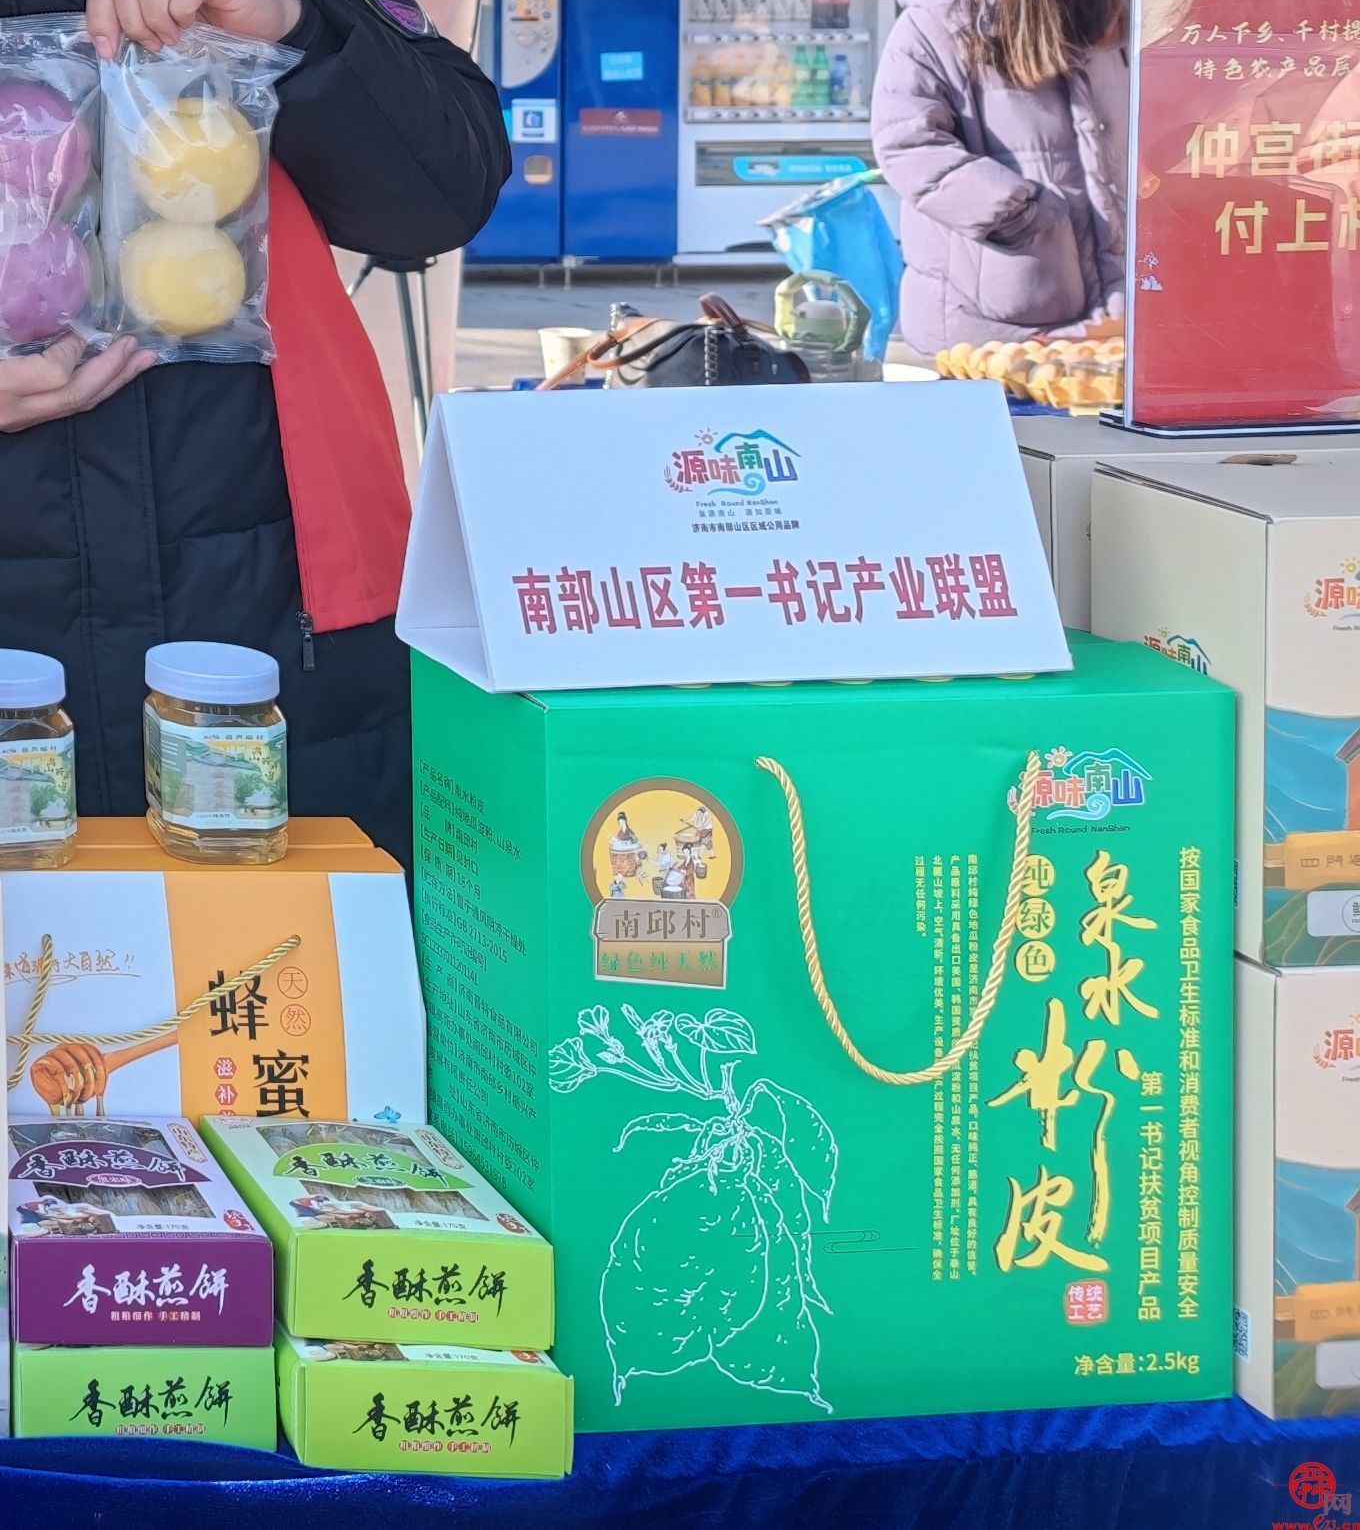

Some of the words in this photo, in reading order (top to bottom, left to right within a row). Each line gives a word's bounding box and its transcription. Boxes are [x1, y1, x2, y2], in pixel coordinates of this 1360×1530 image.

[671, 441, 799, 485] 源味南山
[512, 552, 1018, 635] 南部山区第一书记产业联盟
[1058, 825, 1088, 834] Round
[612, 907, 714, 941] 南邱村
[1020, 859, 1053, 976] 纯绿色
[208, 969, 310, 1118] 蜂蜜
[281, 969, 309, 1033] 天然
[985, 847, 1160, 1274] 泉水粉皮
[1176, 845, 1202, 1319] 按国家食品卫生标准和消费者视角控制质量安全
[1137, 1069, 1165, 1321] 第一书记扶贫项目产品
